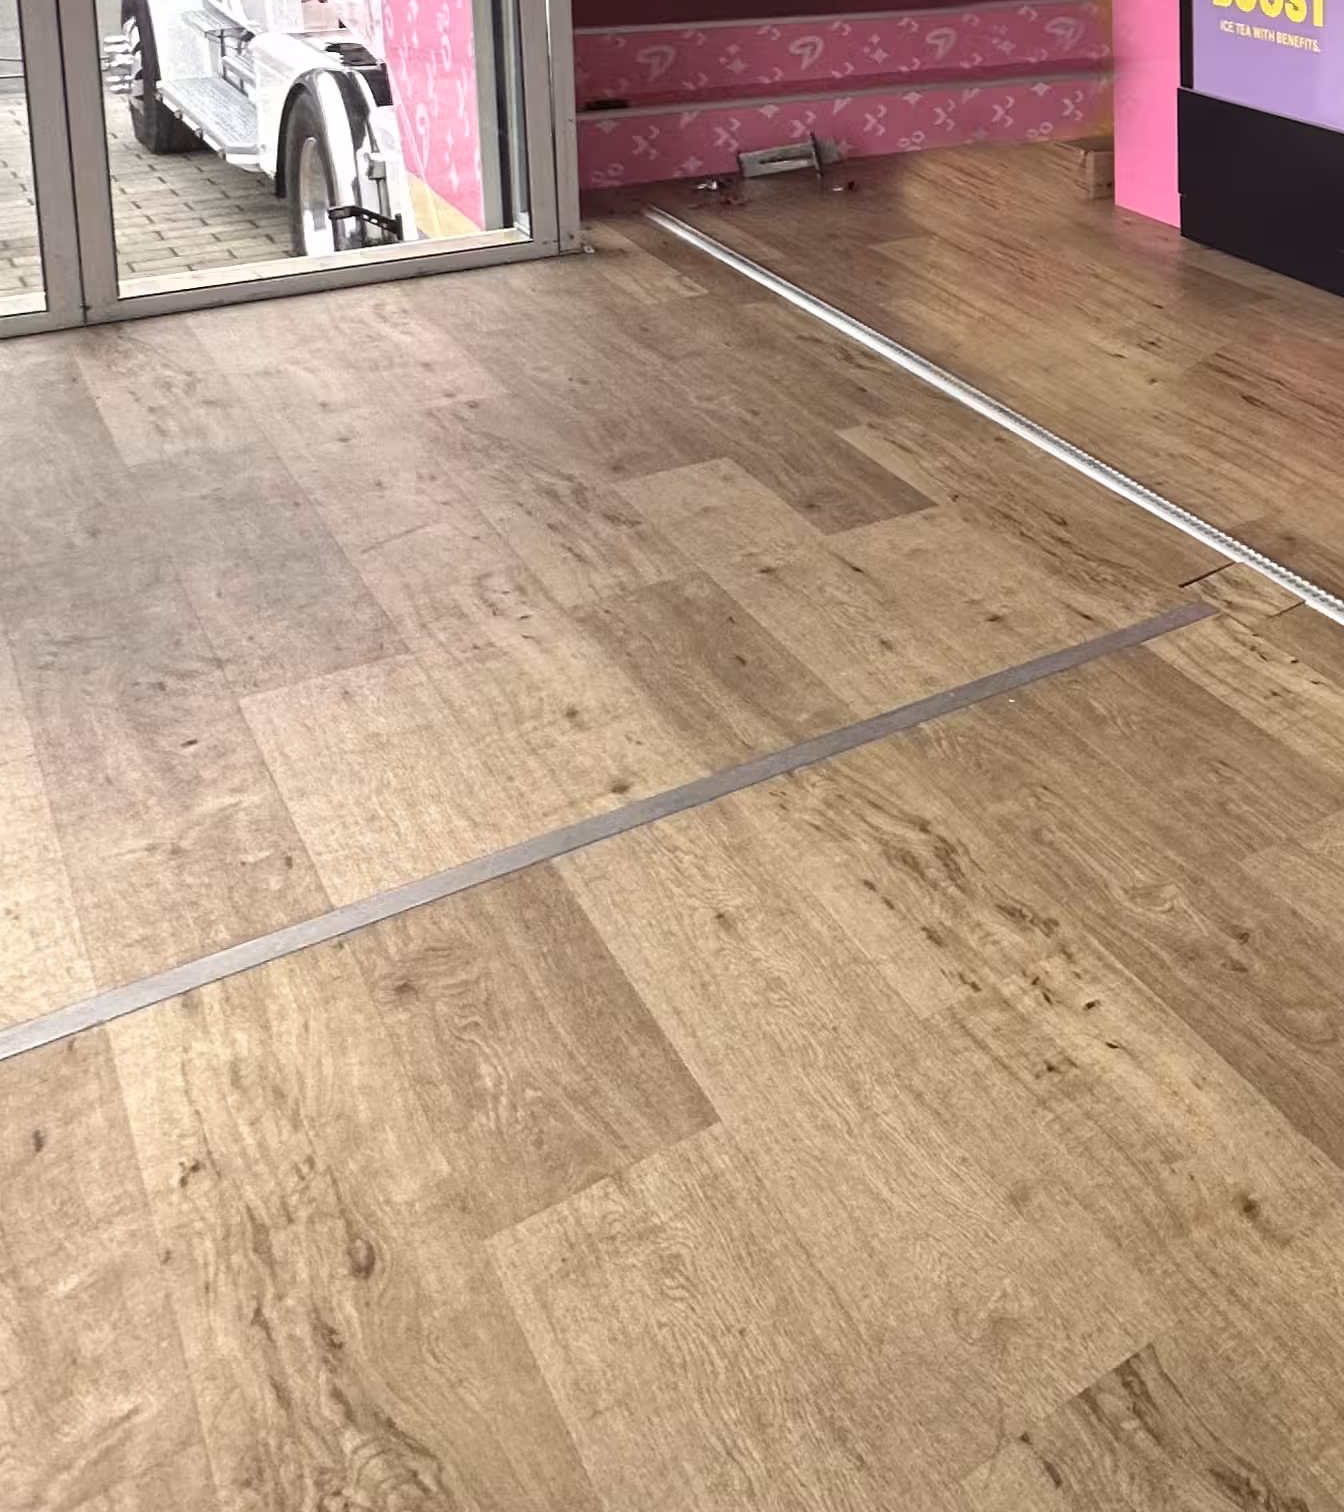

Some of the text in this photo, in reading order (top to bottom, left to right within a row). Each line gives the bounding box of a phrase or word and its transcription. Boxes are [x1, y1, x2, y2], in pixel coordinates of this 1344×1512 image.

[1219, 19, 1321, 53] ICE TEA WITH BENEFITS.
